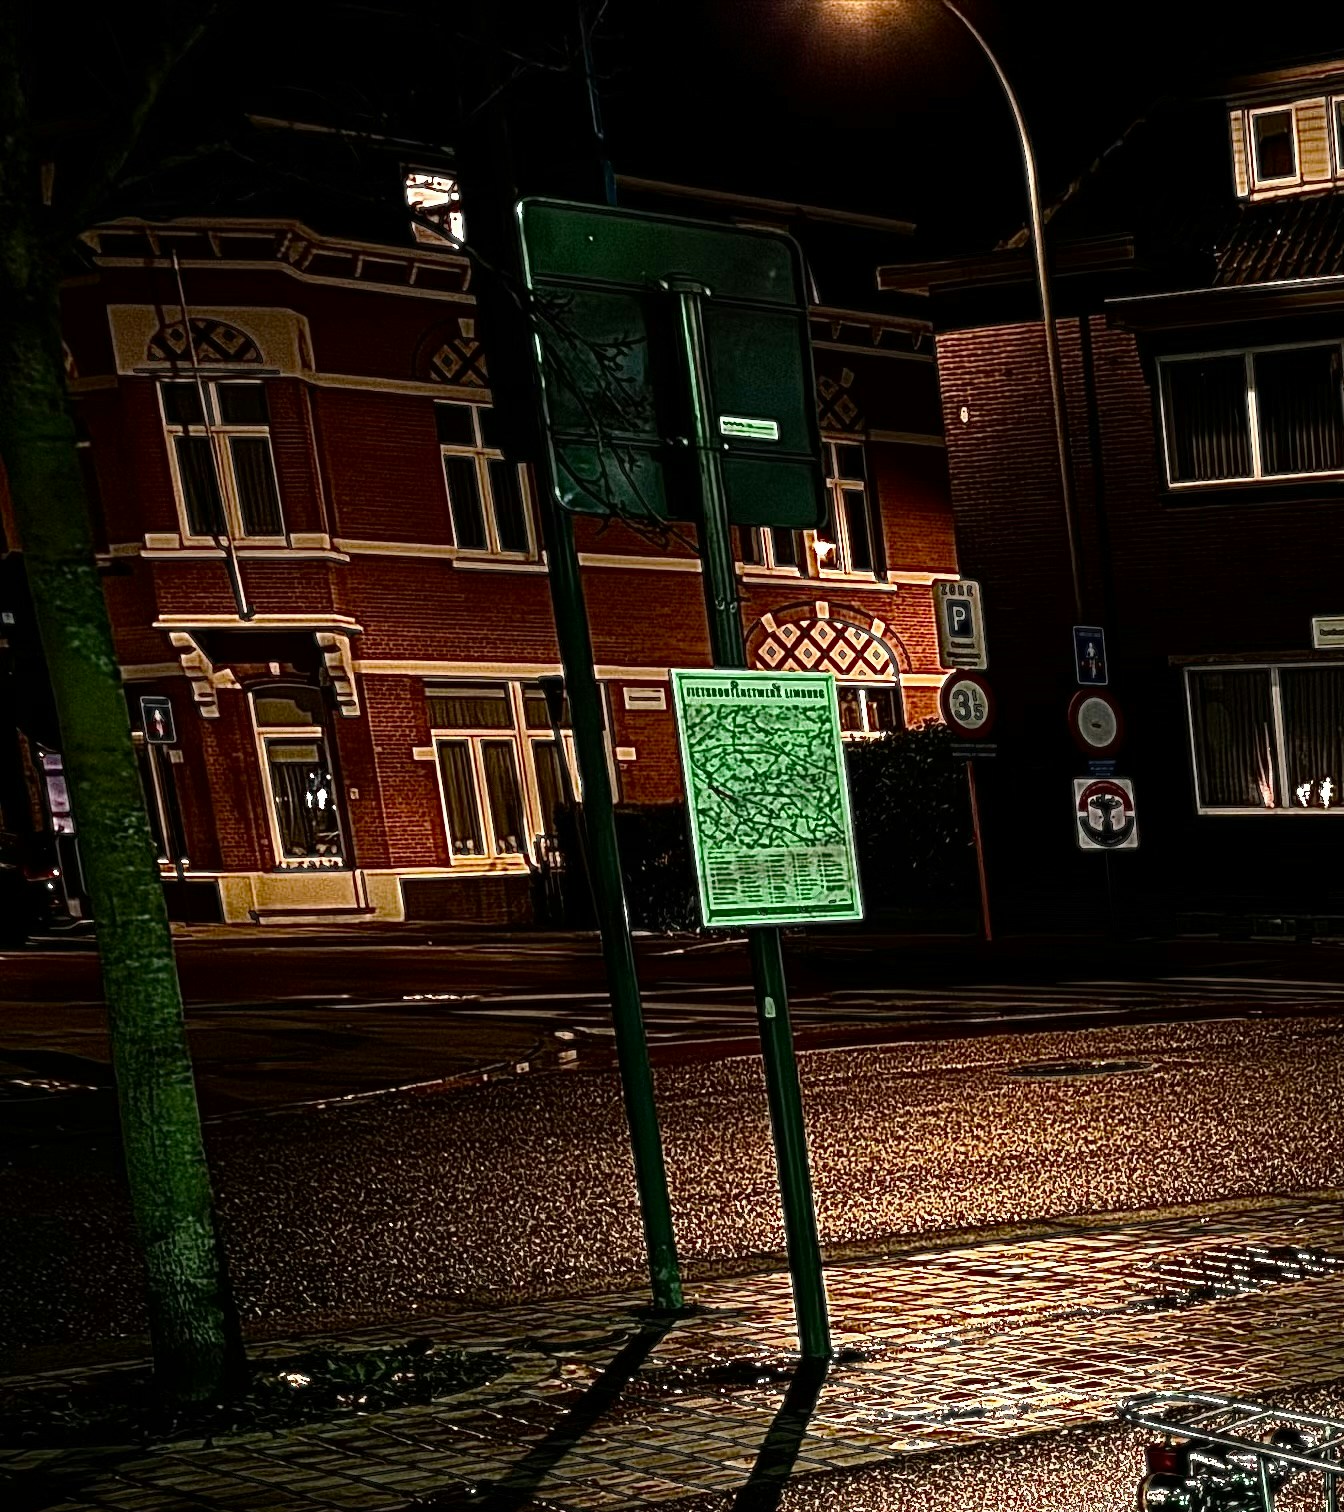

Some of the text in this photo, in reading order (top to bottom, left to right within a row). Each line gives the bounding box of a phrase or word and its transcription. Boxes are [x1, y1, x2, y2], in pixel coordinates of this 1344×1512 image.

[940, 583, 974, 597] ZONE
[952, 606, 966, 631] P
[784, 688, 825, 699] LIMBURG
